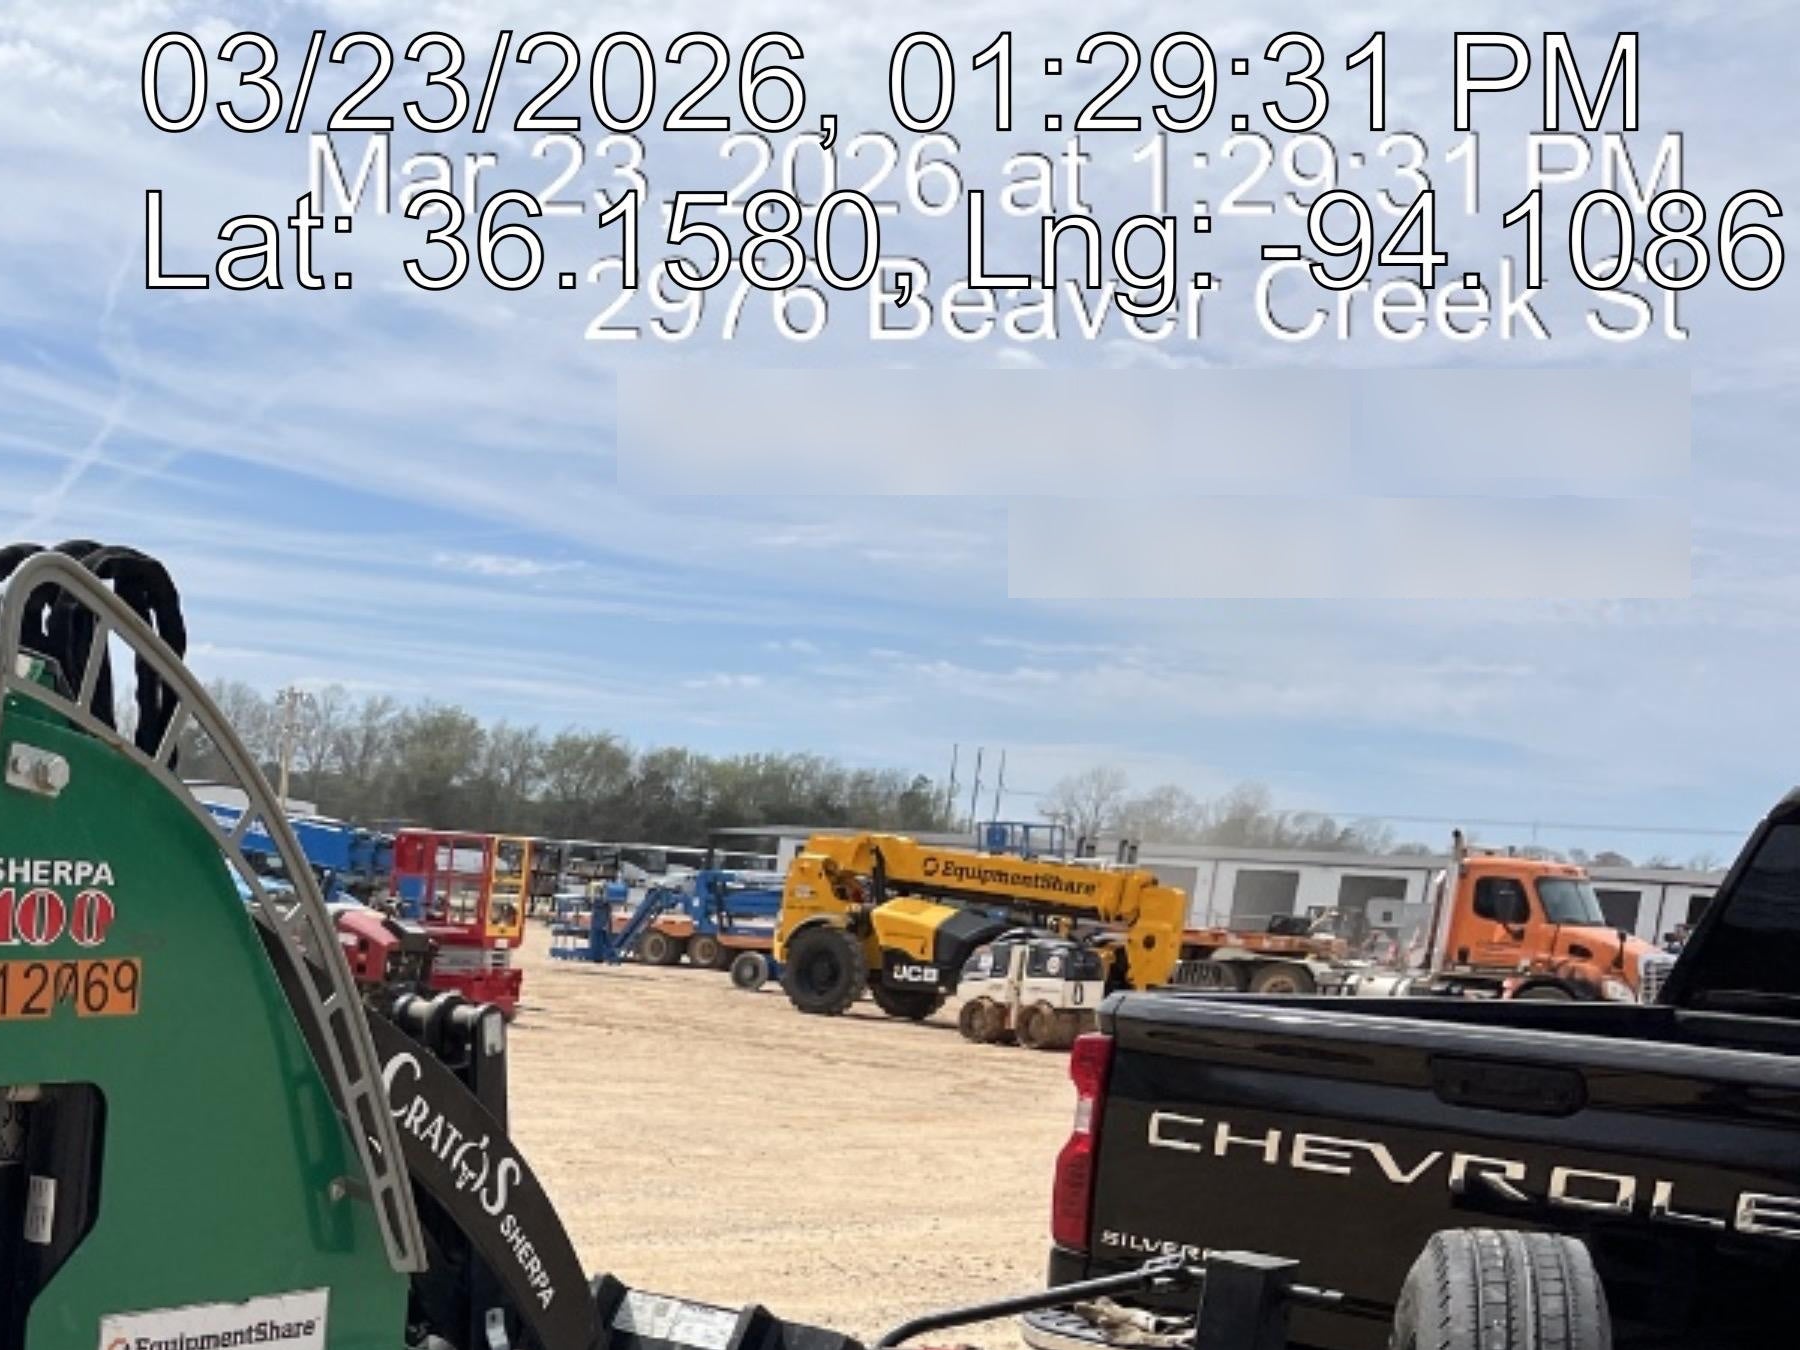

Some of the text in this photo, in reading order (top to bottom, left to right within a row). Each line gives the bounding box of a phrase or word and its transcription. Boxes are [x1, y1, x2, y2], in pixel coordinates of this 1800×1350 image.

[942, 860, 1096, 897] EquipmentShare
[893, 964, 939, 982] JCB
[500, 1214, 555, 1309] SHERPA
[1101, 1228, 1209, 1262] SILVER
